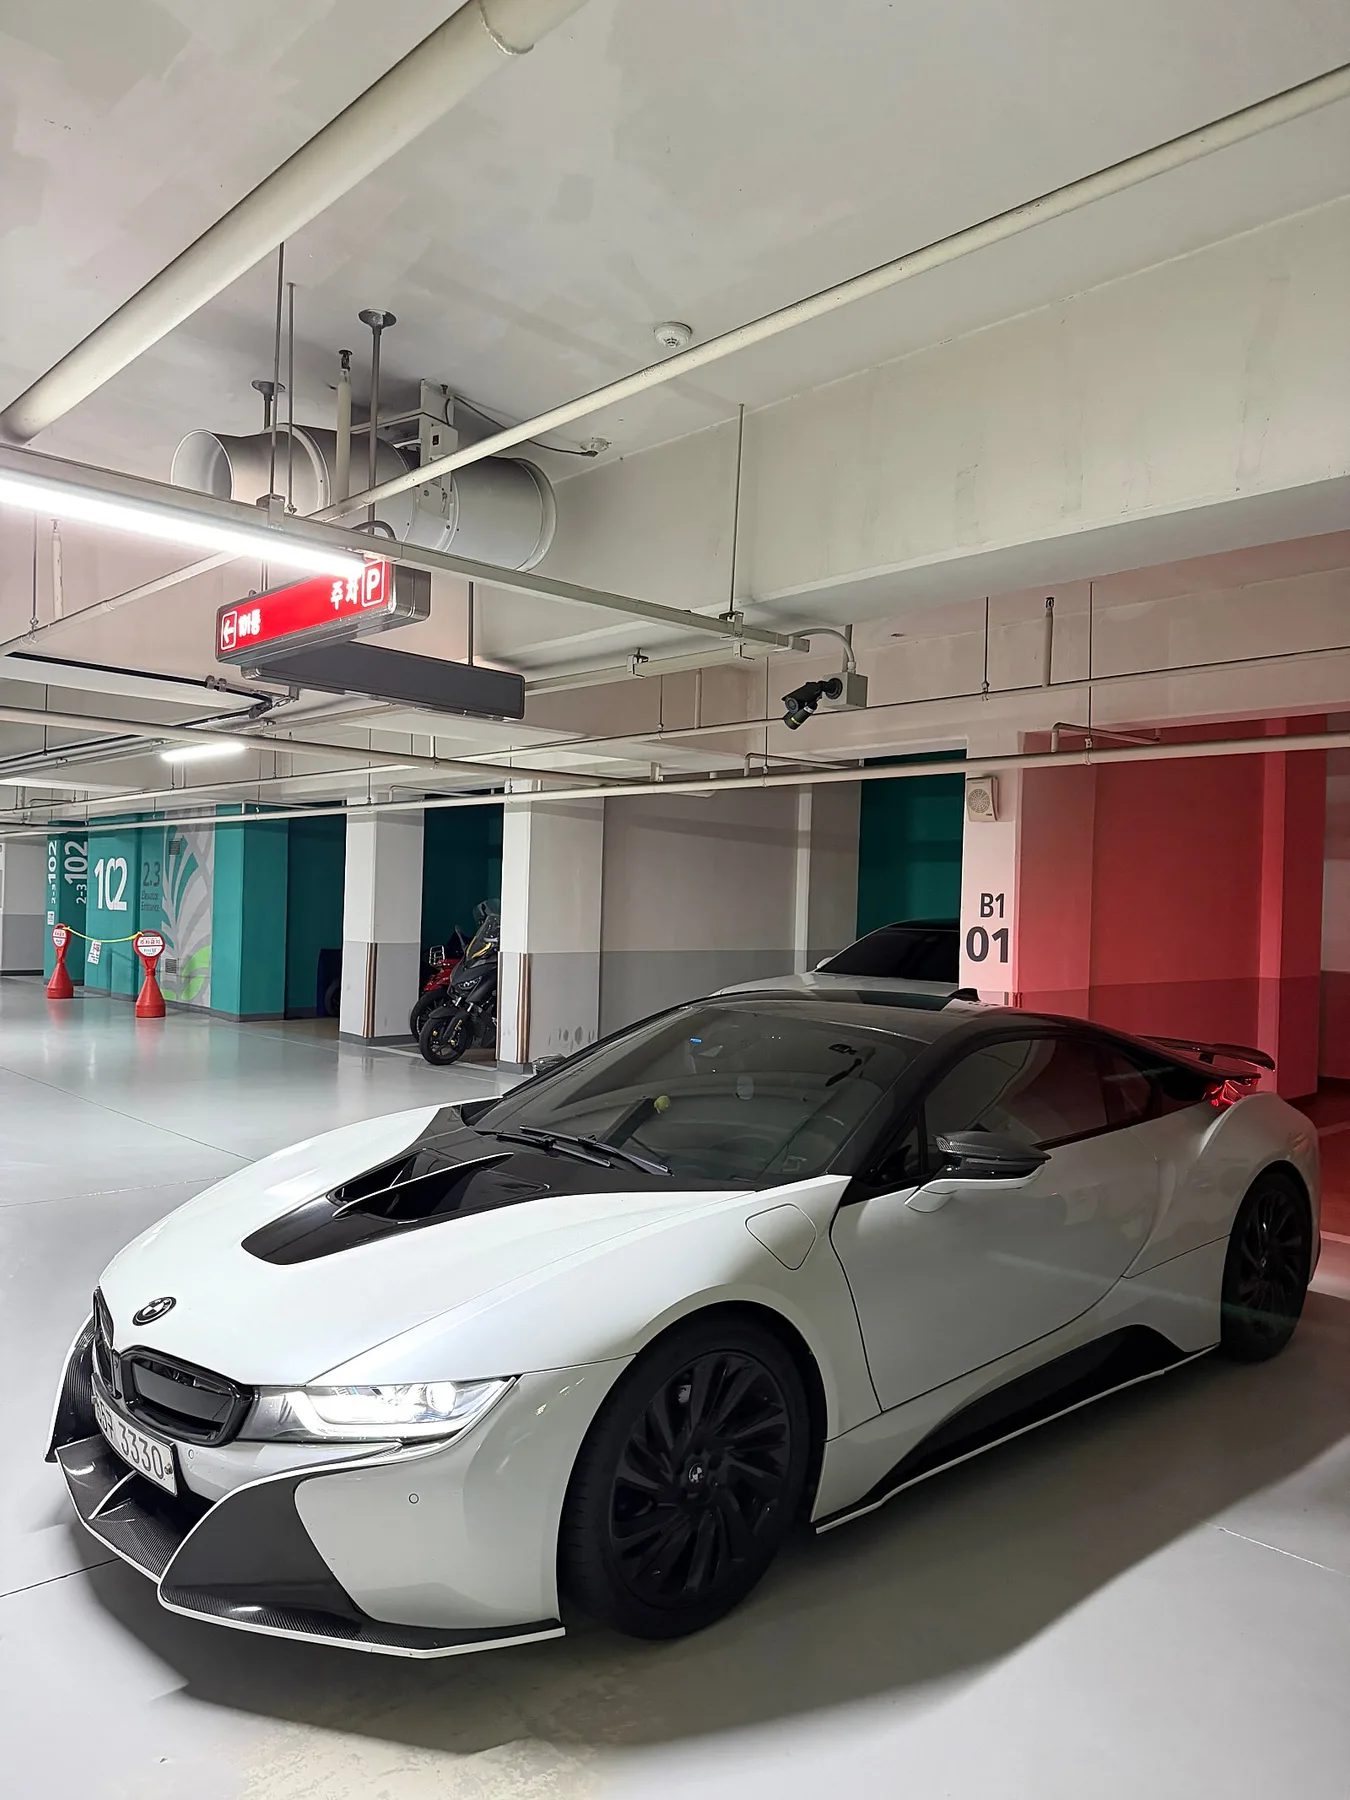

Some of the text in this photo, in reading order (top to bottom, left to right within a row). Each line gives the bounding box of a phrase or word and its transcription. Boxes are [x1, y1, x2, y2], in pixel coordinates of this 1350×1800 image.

[331, 575, 359, 610] 주차
[367, 568, 380, 600] P
[48, 841, 57, 884] 102
[64, 841, 88, 904] 2-3 102
[94, 857, 128, 911] 102
[980, 892, 1005, 918] B1
[966, 926, 1009, 964] 01
[120, 1424, 163, 1479] 3330
